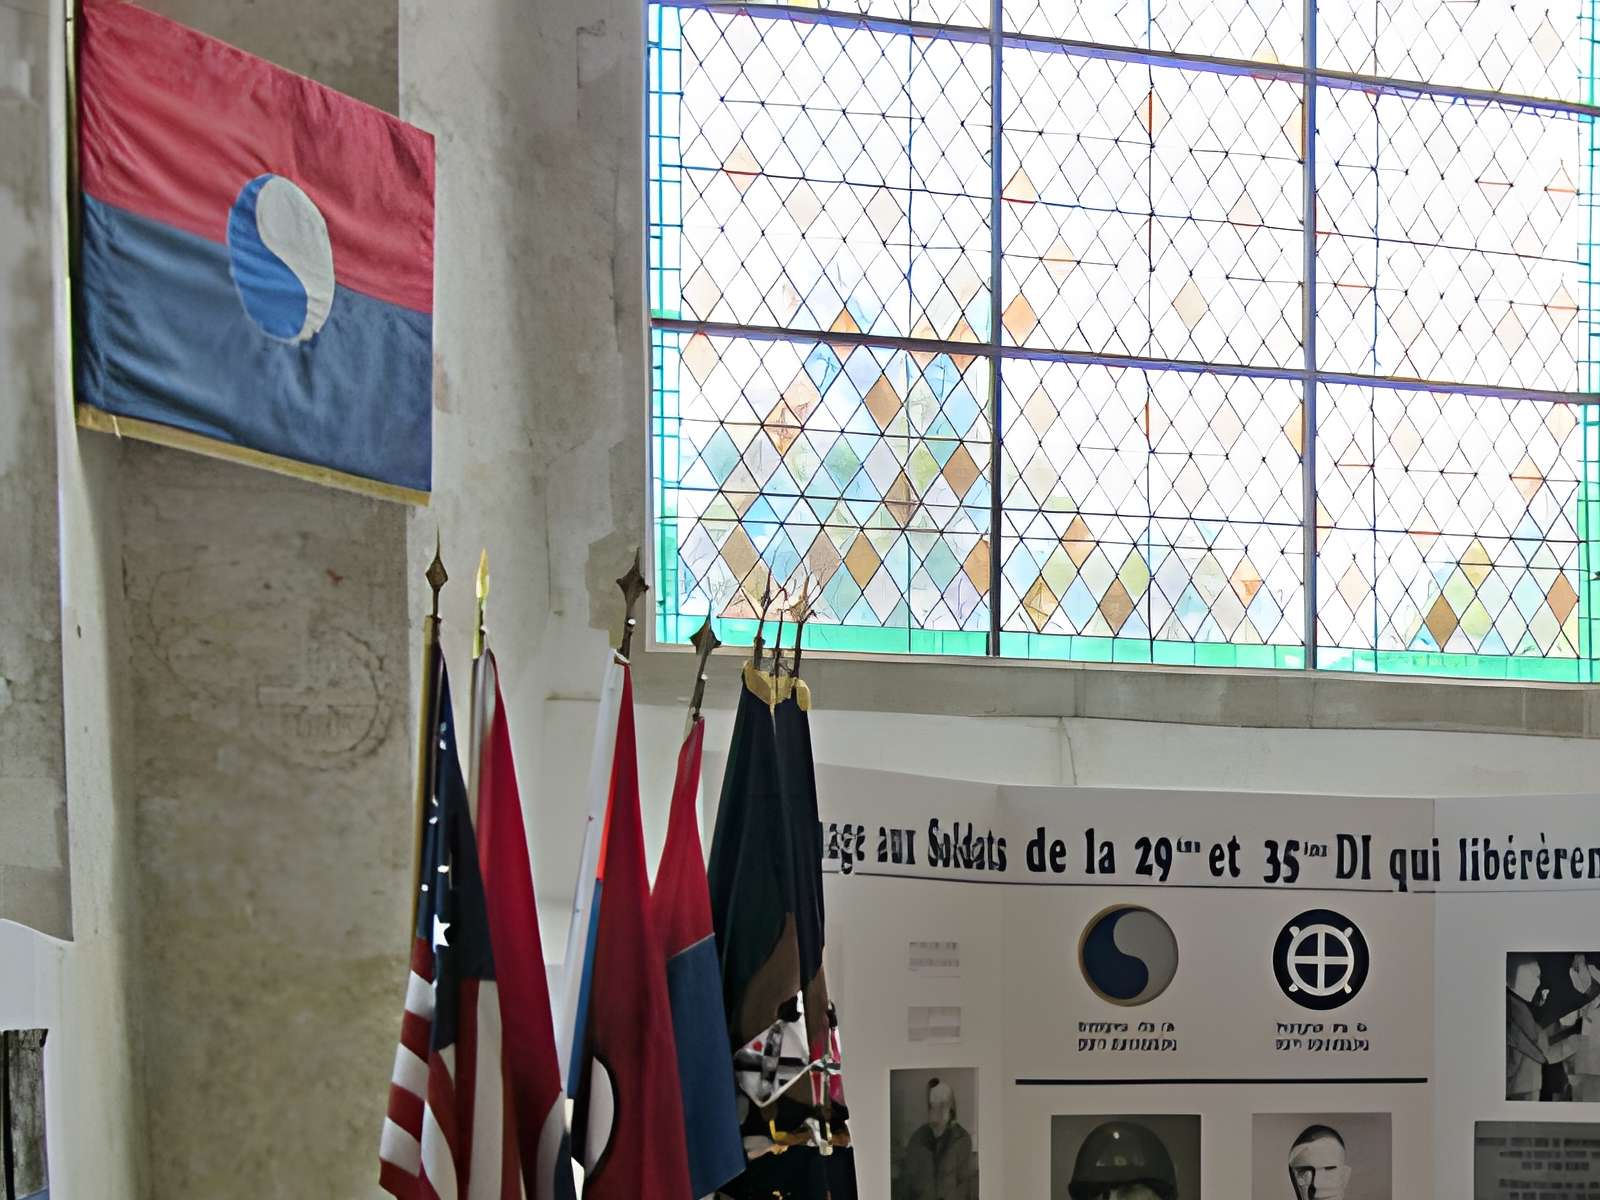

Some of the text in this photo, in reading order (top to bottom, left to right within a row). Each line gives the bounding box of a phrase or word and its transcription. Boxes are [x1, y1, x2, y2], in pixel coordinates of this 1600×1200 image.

[927, 817, 1007, 872] Soldats
[1026, 826, 1067, 874] de
[1084, 827, 1116, 874] la
[1208, 835, 1241, 878] et
[1336, 833, 1372, 881] DI
[1389, 837, 1441, 893] qui
